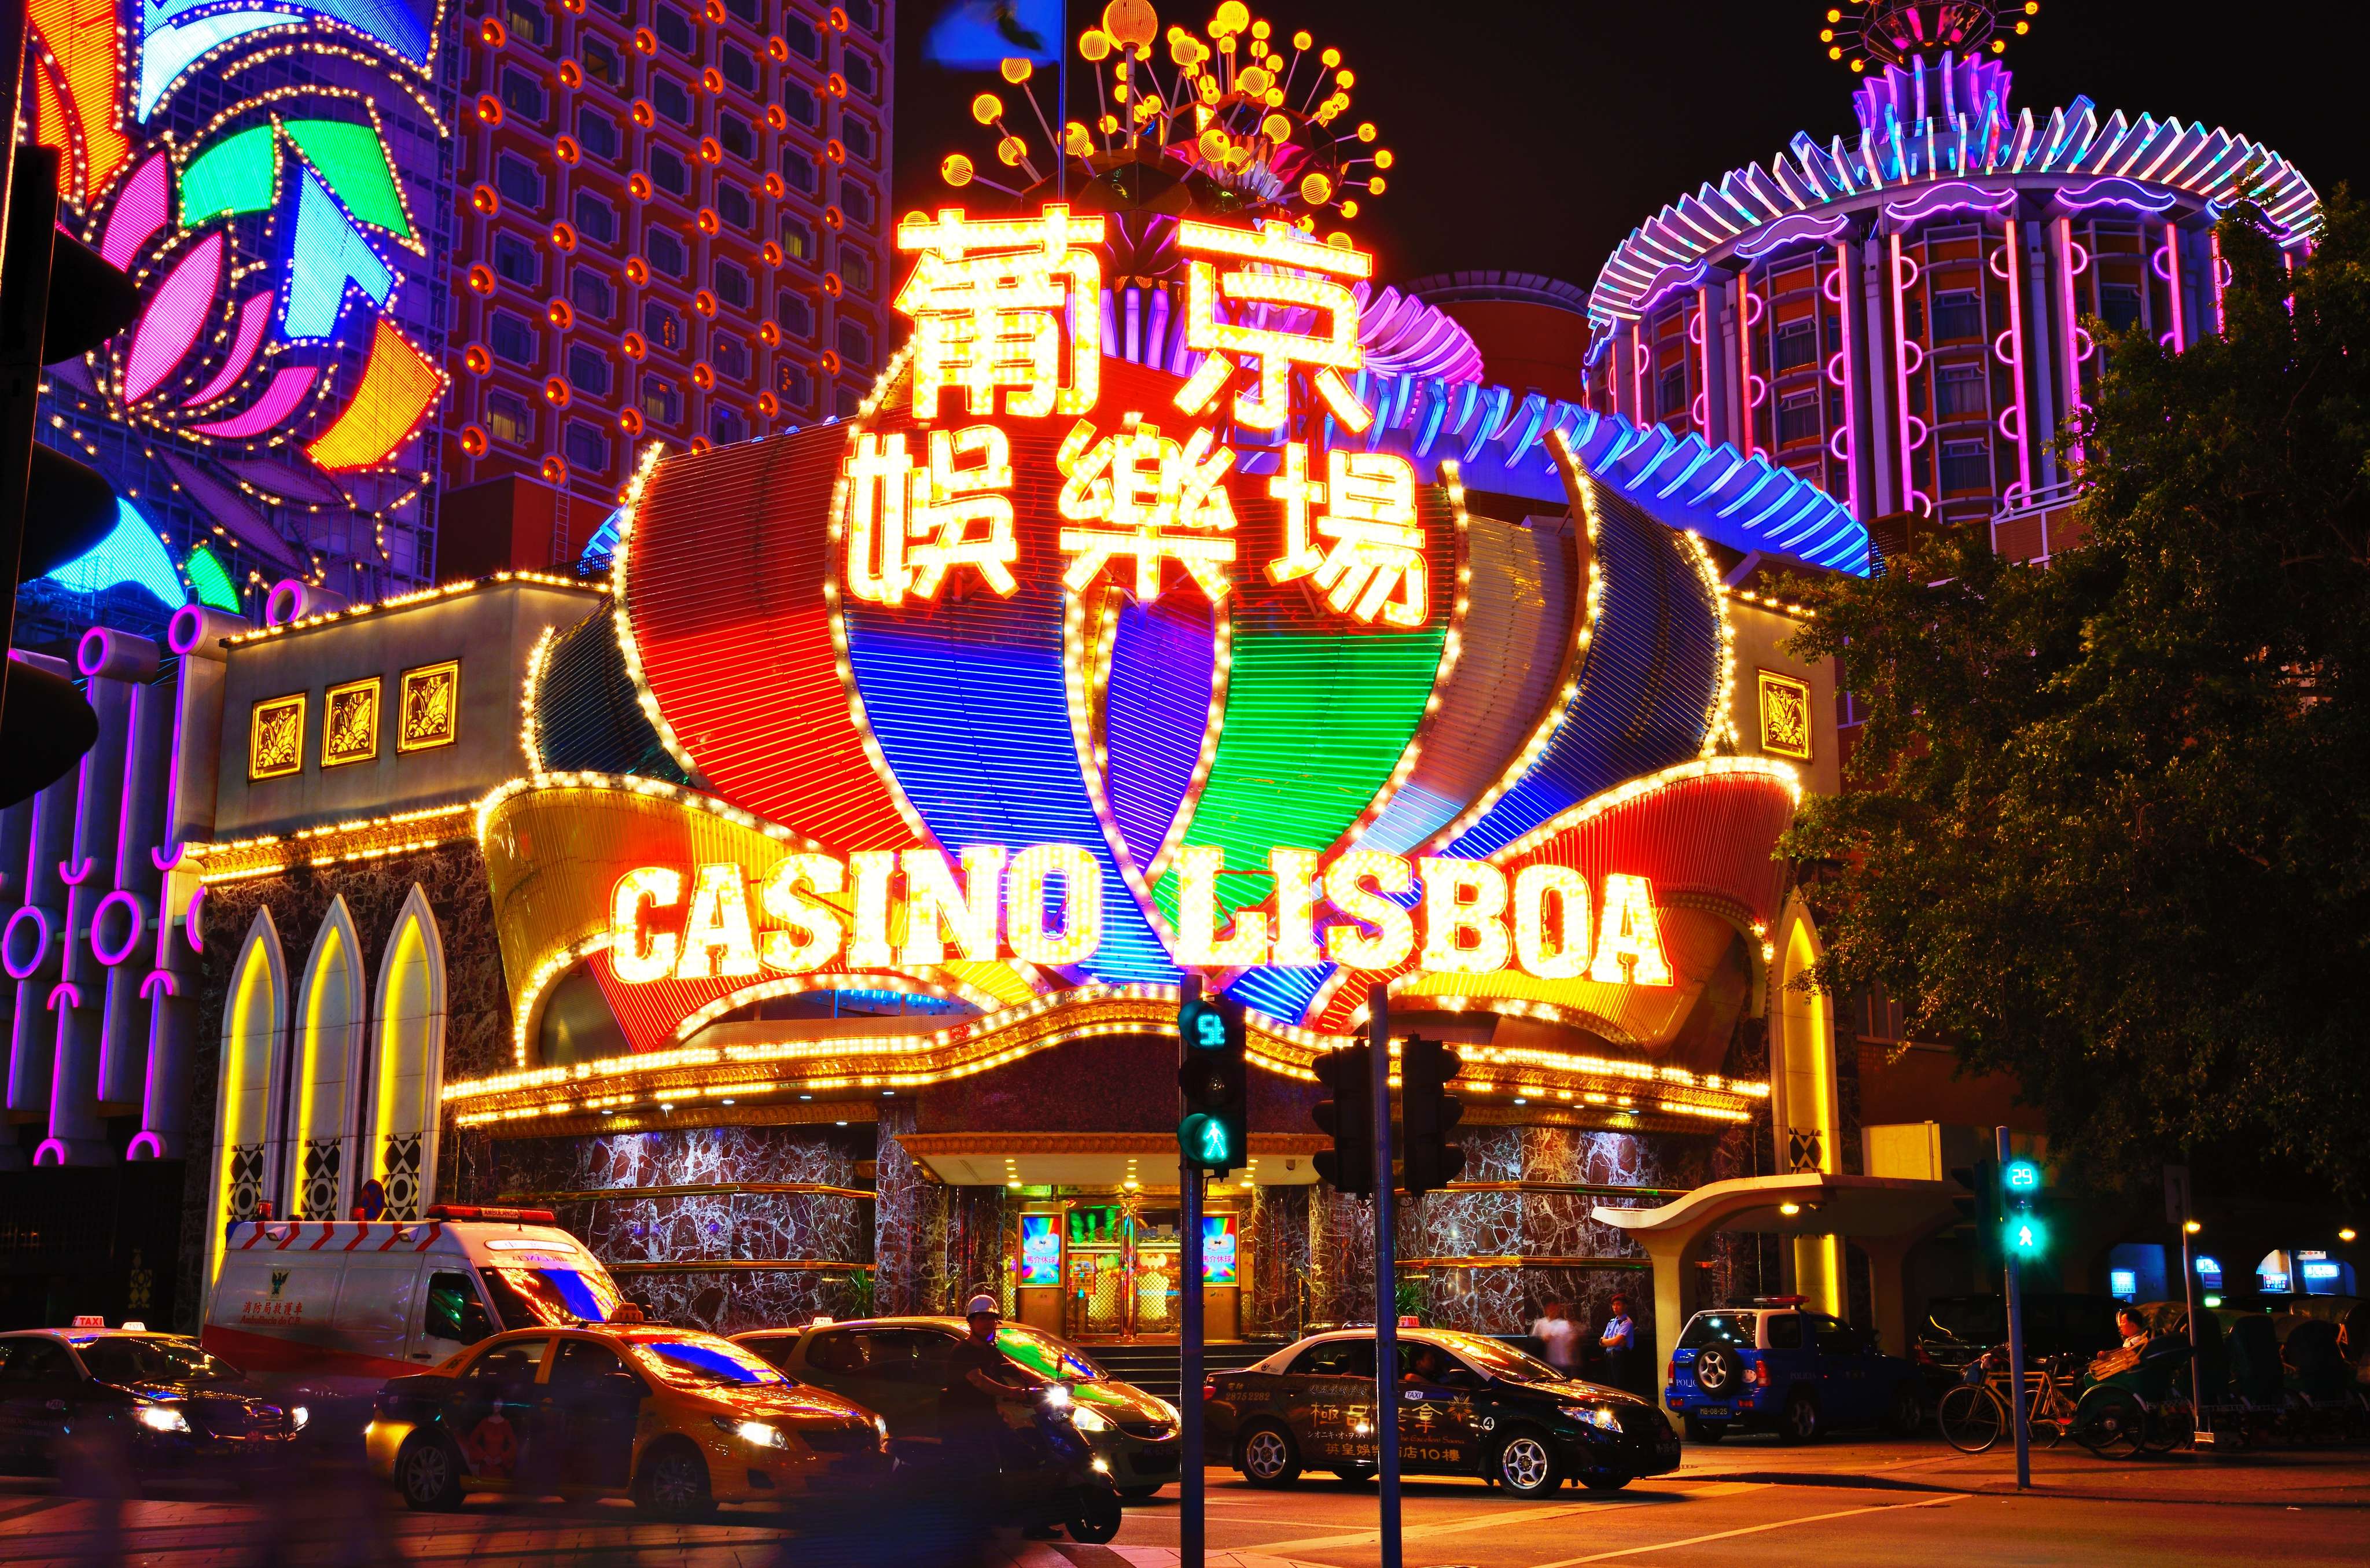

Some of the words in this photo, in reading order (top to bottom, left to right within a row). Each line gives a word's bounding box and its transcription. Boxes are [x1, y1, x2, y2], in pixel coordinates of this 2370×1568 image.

[894, 204, 1374, 434] 葡京
[843, 414, 1429, 627] 娛樂場
[608, 844, 1103, 984] CASINO
[1173, 845, 1674, 987] LISBOA
[2012, 1169, 2033, 1185] 29
[243, 1301, 303, 1315] 消防局救護車
[1224, 1392, 1270, 1401] 28752282
[1484, 1418, 1492, 1429] 4
